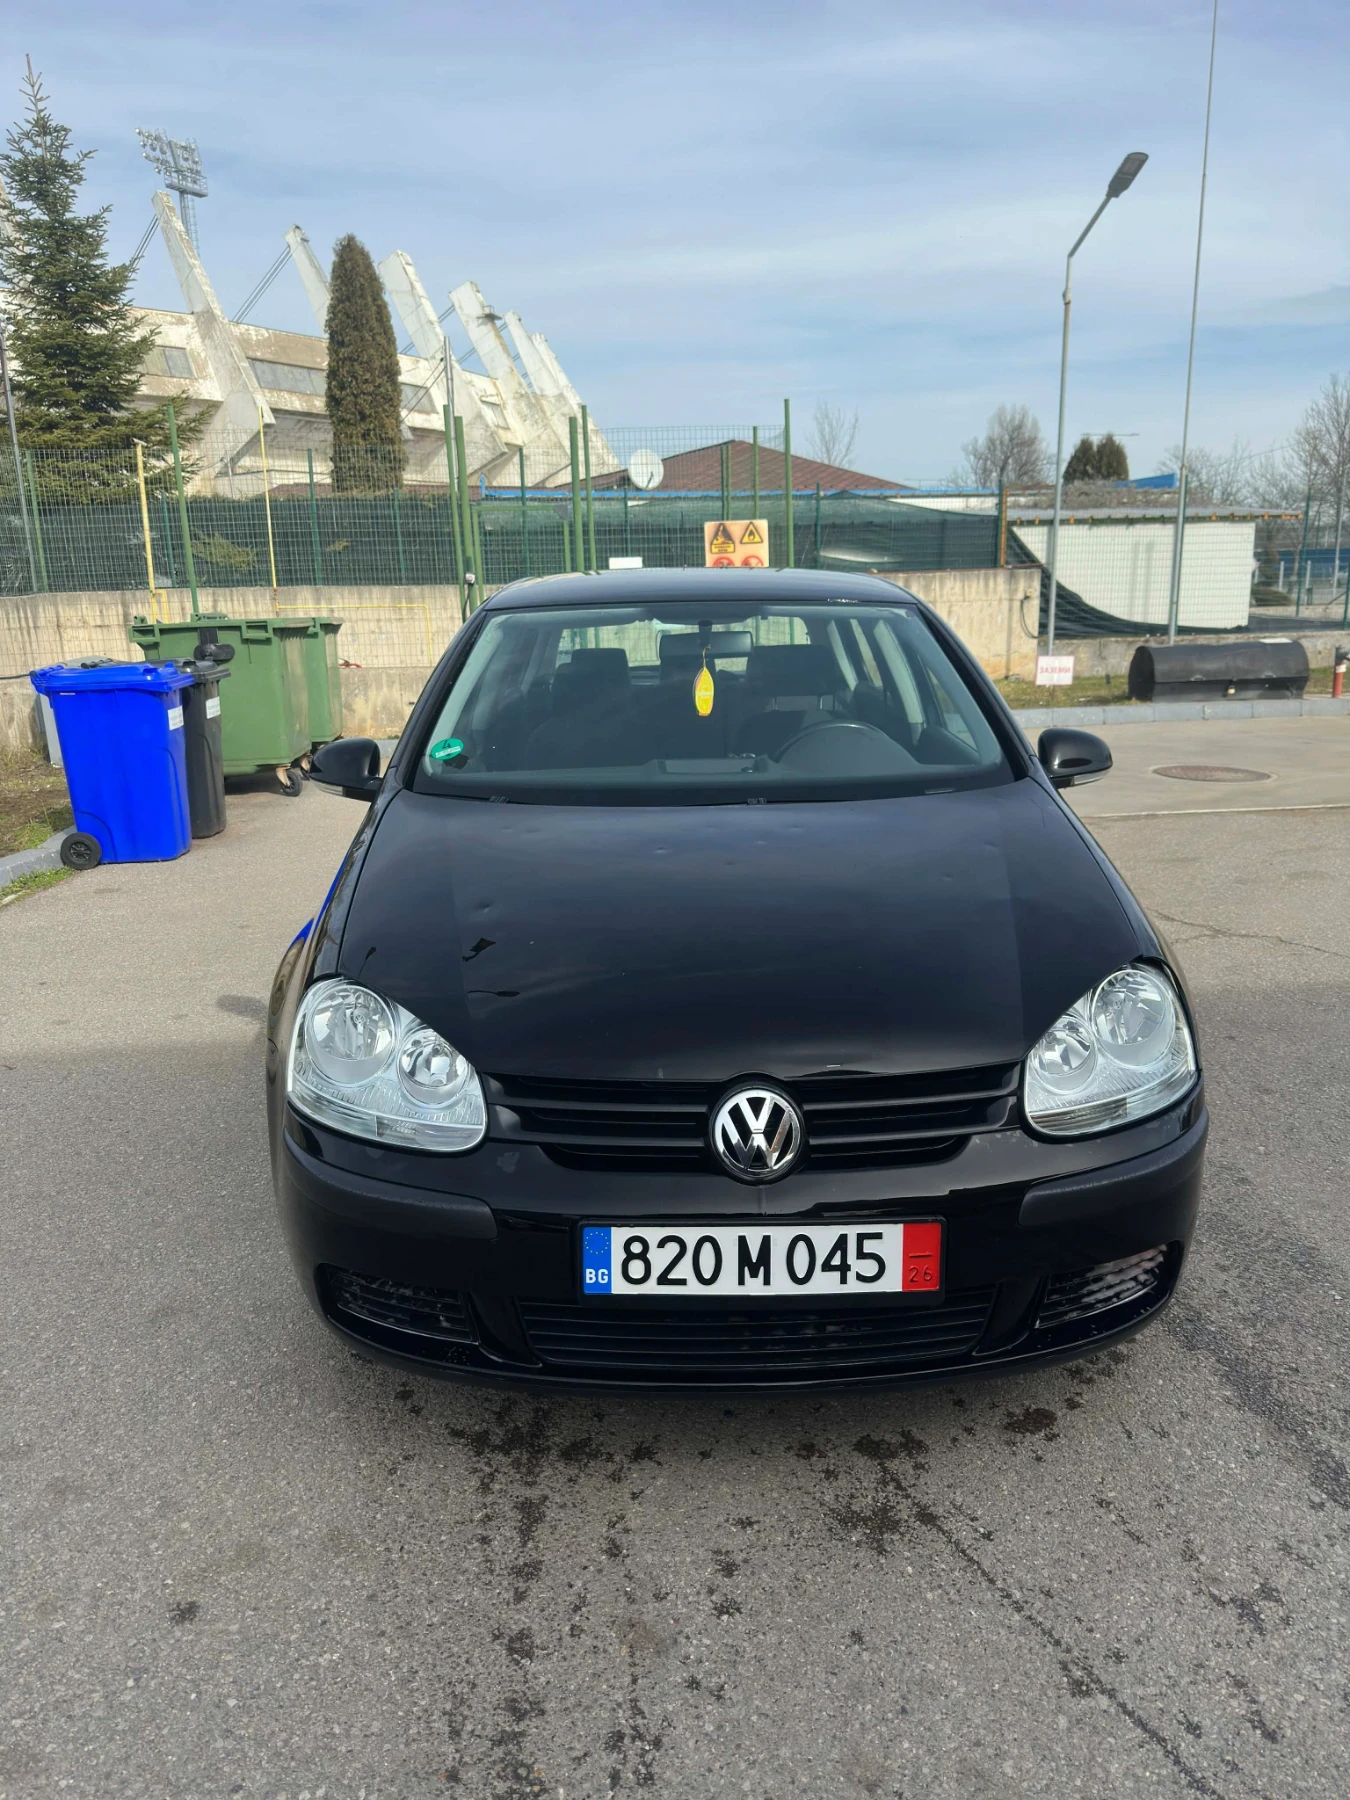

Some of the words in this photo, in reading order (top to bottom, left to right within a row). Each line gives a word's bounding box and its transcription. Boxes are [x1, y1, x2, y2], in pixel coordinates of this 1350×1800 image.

[621, 1234, 723, 1286] 820
[737, 1234, 771, 1286] M
[786, 1232, 886, 1286] 045
[585, 1268, 609, 1284] BG
[908, 1265, 932, 1283] 26
